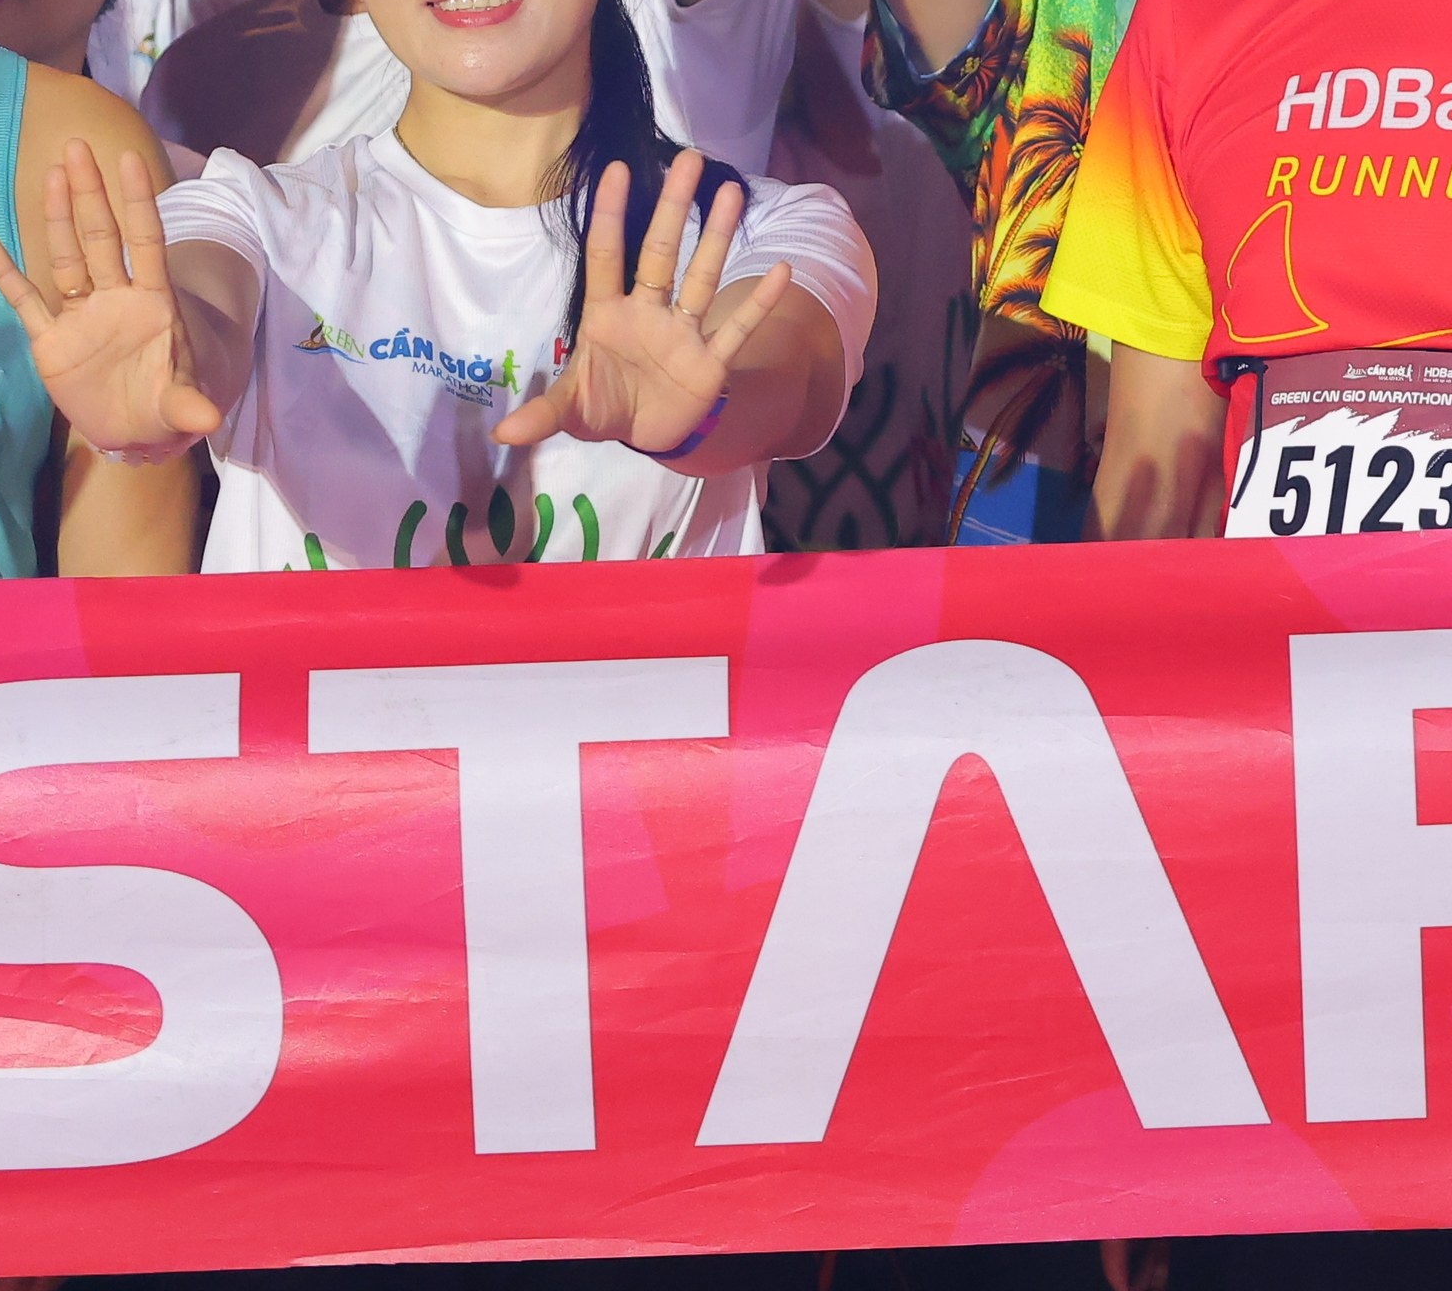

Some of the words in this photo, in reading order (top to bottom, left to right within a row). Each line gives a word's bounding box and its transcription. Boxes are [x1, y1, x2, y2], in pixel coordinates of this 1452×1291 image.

[370, 328, 433, 361] CẦN
[412, 361, 493, 397] MARATHON
[1271, 390, 1310, 405] GREEN
[1312, 390, 1339, 403] CAN
[1342, 390, 1366, 403] GIO
[1369, 390, 1452, 407] MARATHON
